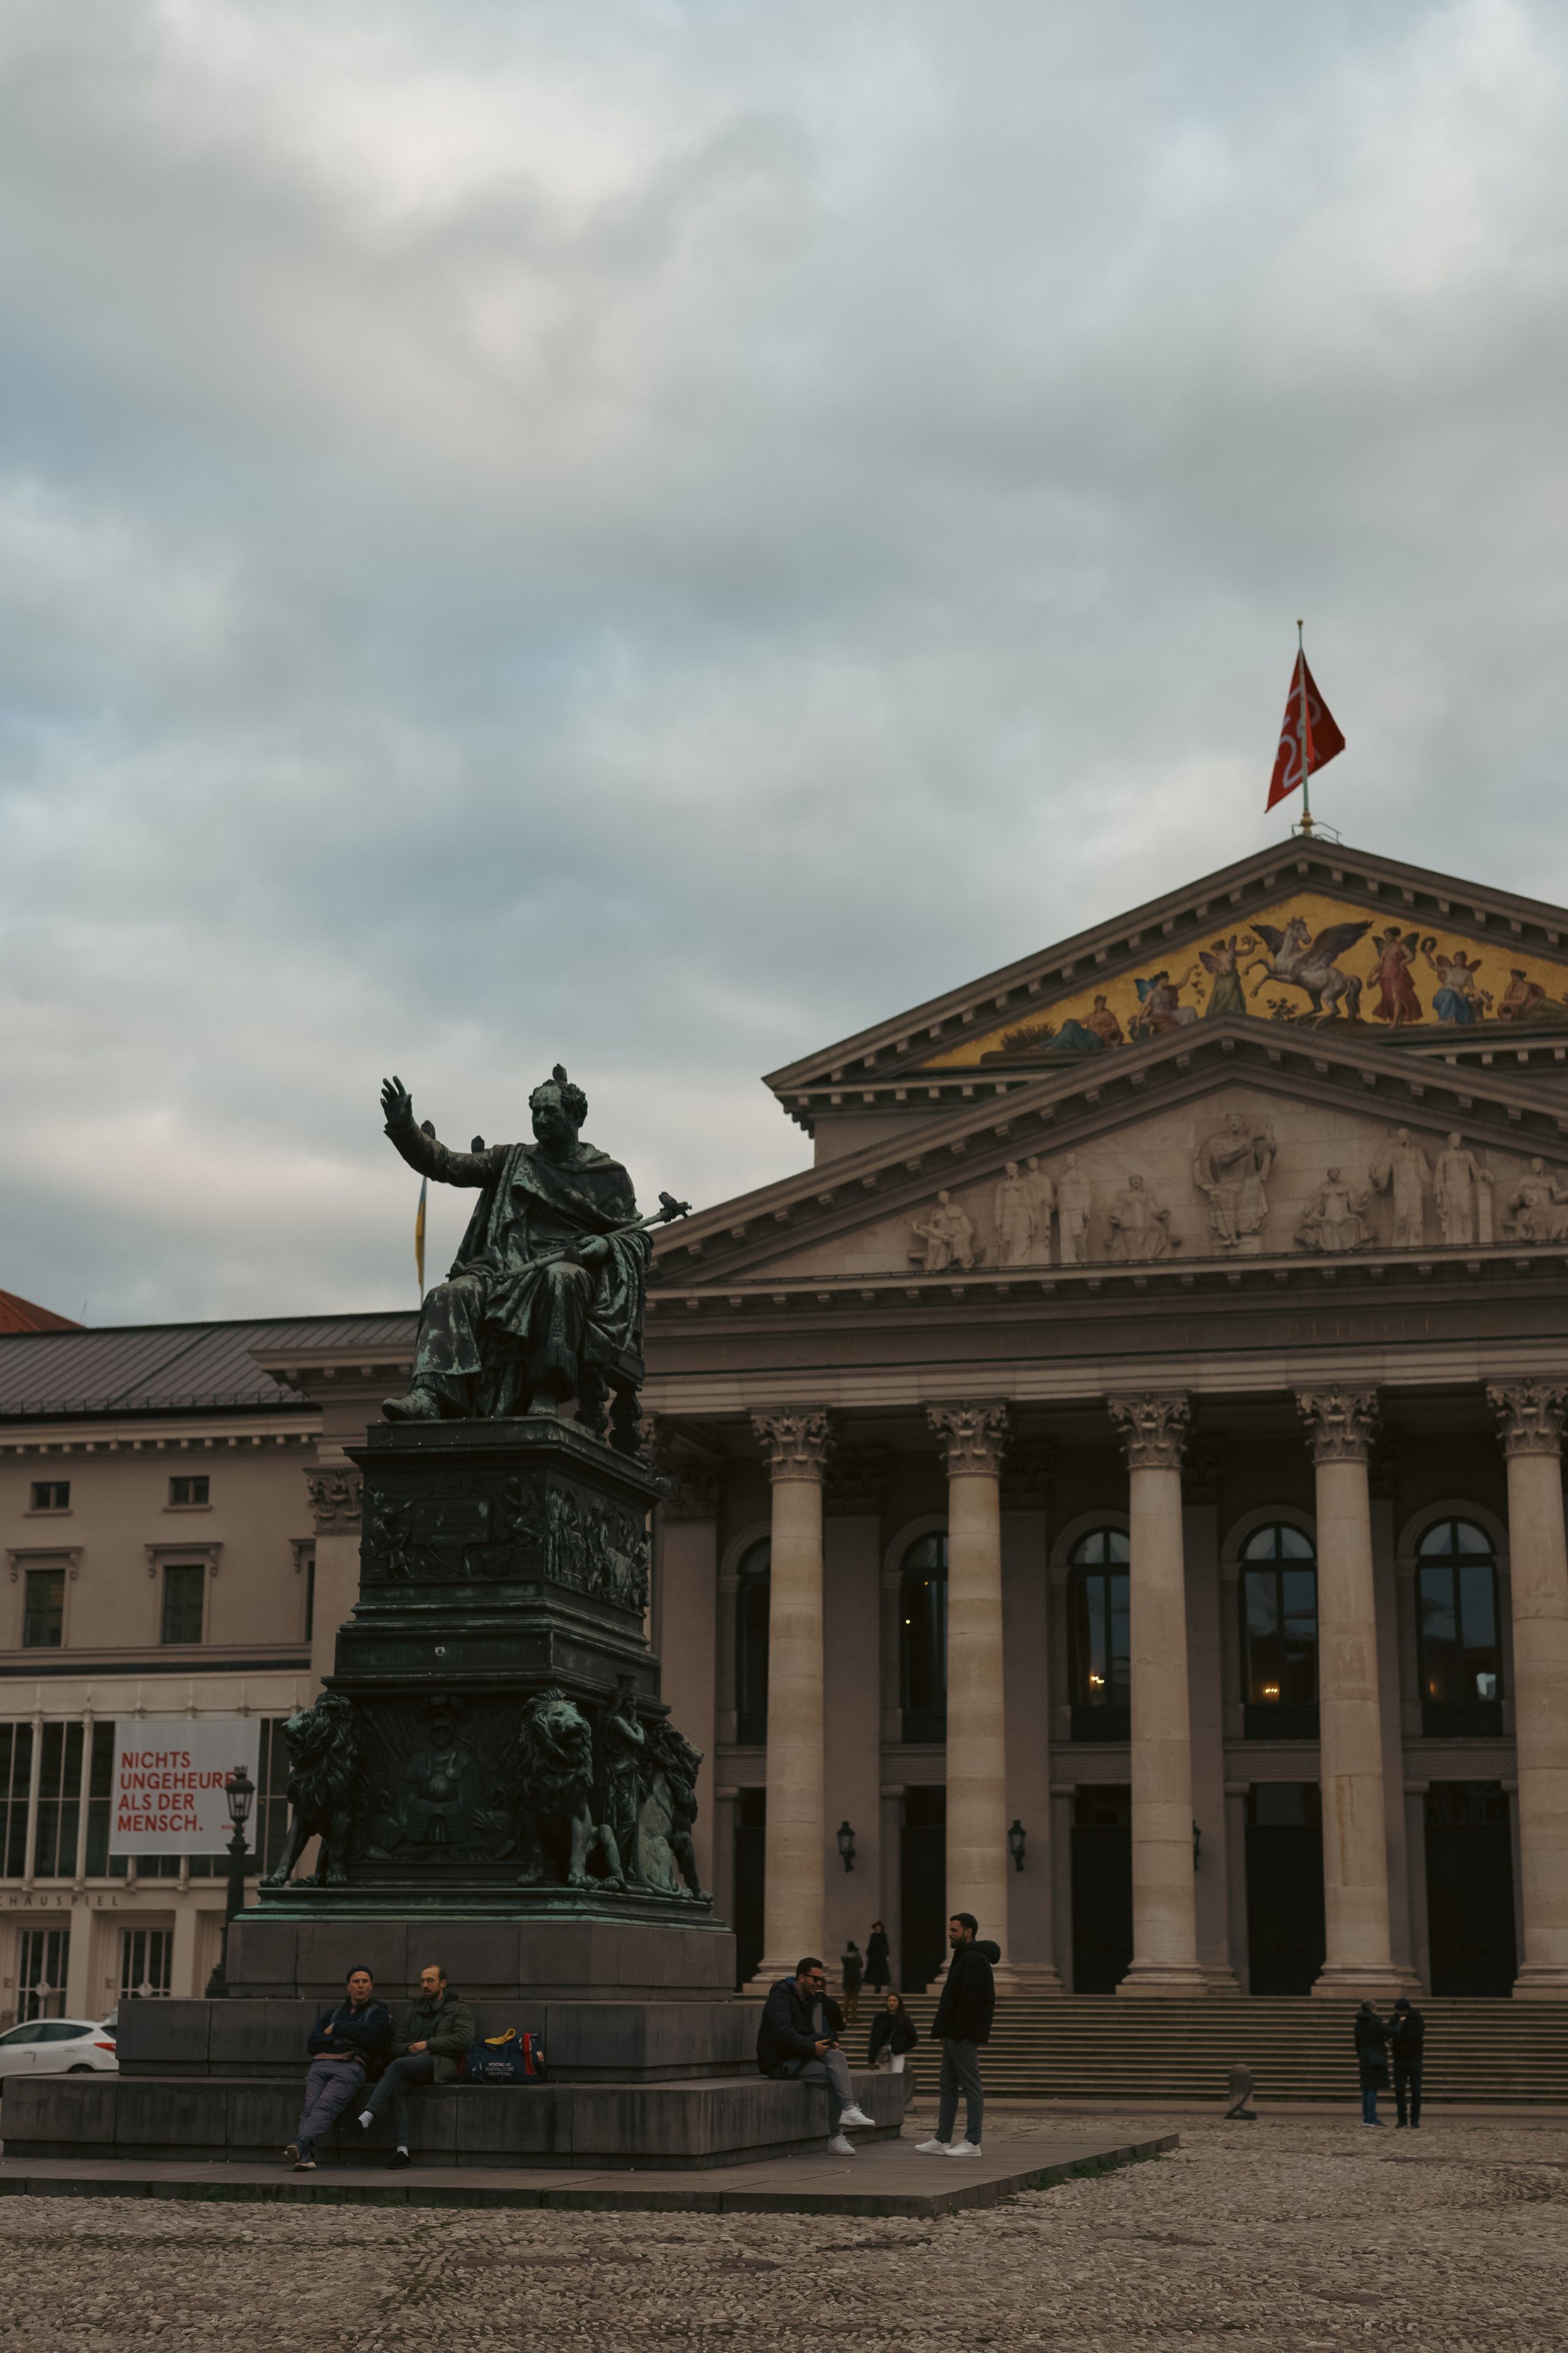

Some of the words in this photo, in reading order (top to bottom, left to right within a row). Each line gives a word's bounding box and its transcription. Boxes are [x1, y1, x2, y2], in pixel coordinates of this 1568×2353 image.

[121, 1751, 191, 1769] NICHTS
[120, 1771, 247, 1790] UNGEHEURE
[118, 1793, 152, 1811] ALS
[158, 1793, 195, 1811] DER
[117, 1814, 204, 1832] MENSCH.
[0, 1895, 118, 1907] HAUSPIEL
